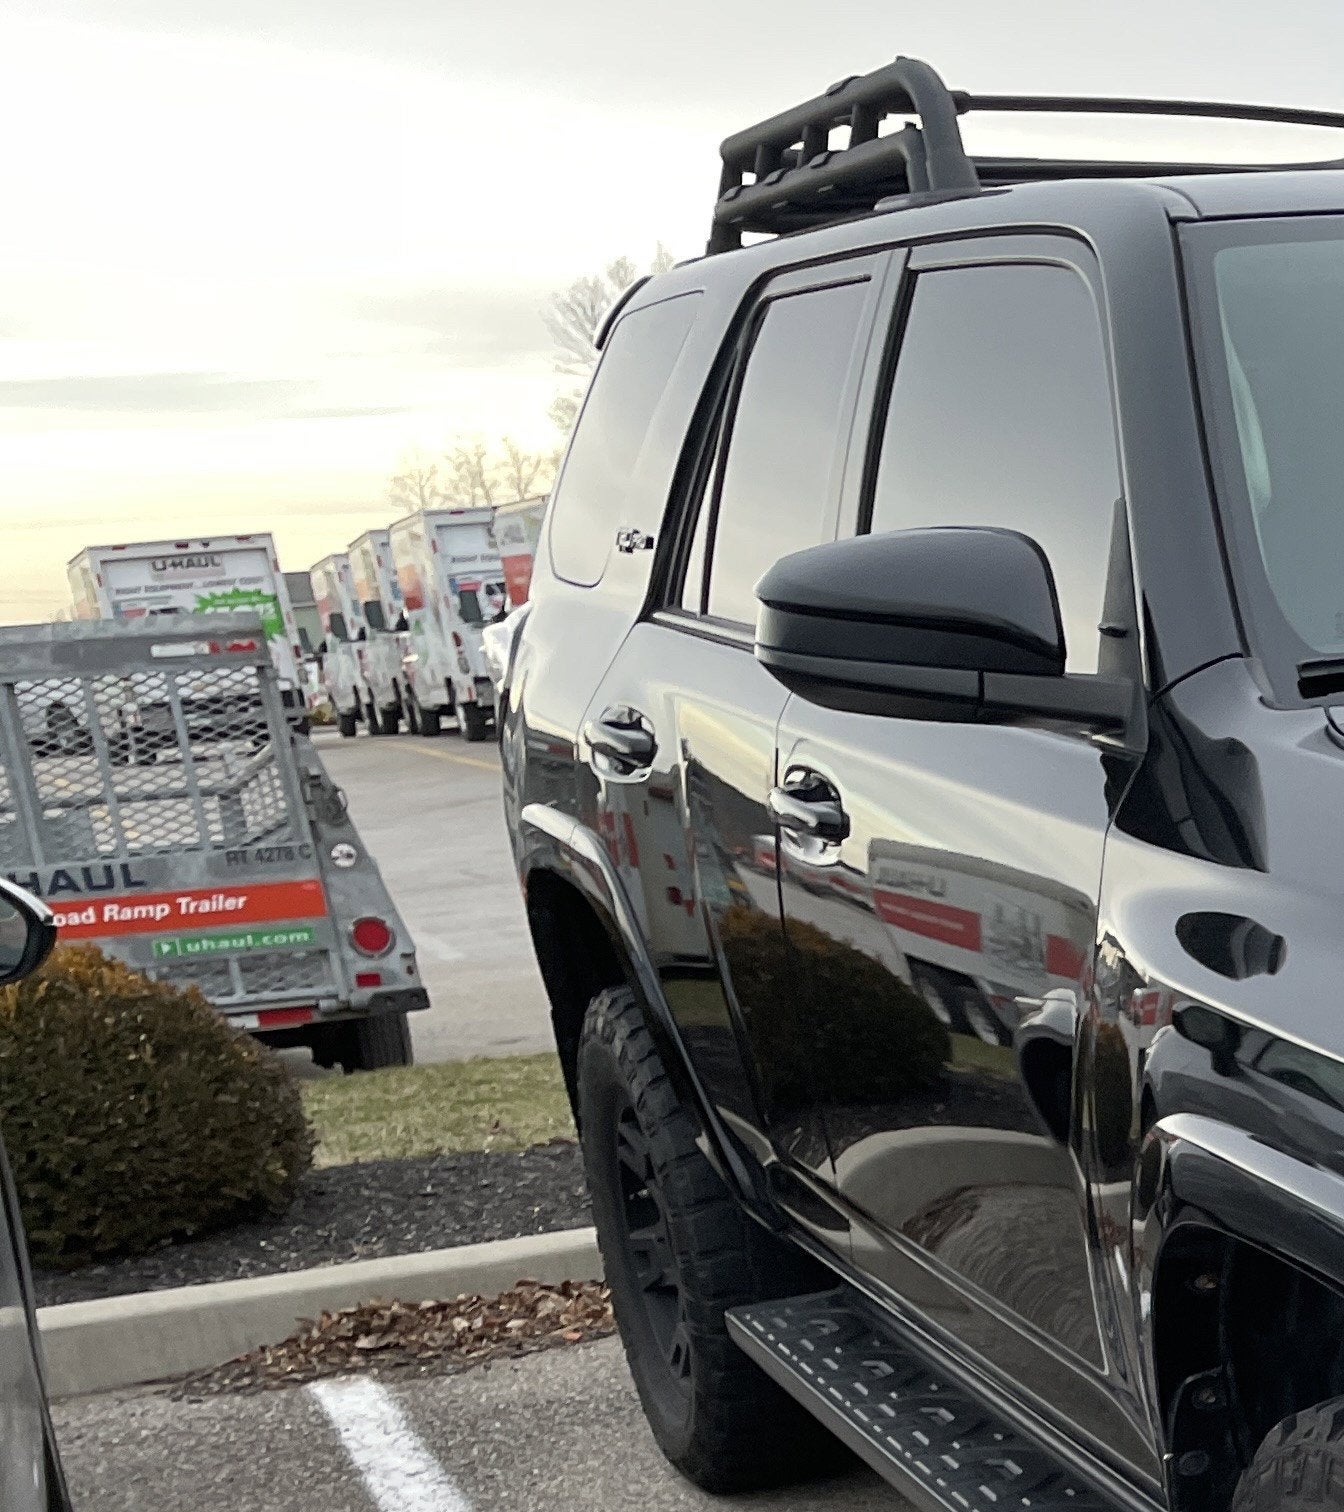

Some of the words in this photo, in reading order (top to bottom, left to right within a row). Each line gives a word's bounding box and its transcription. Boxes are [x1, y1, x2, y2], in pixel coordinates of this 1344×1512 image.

[53, 905, 96, 928] oad
[103, 903, 171, 922] Ramp
[176, 893, 248, 915] Trailer
[186, 928, 311, 952] uhaul.com
